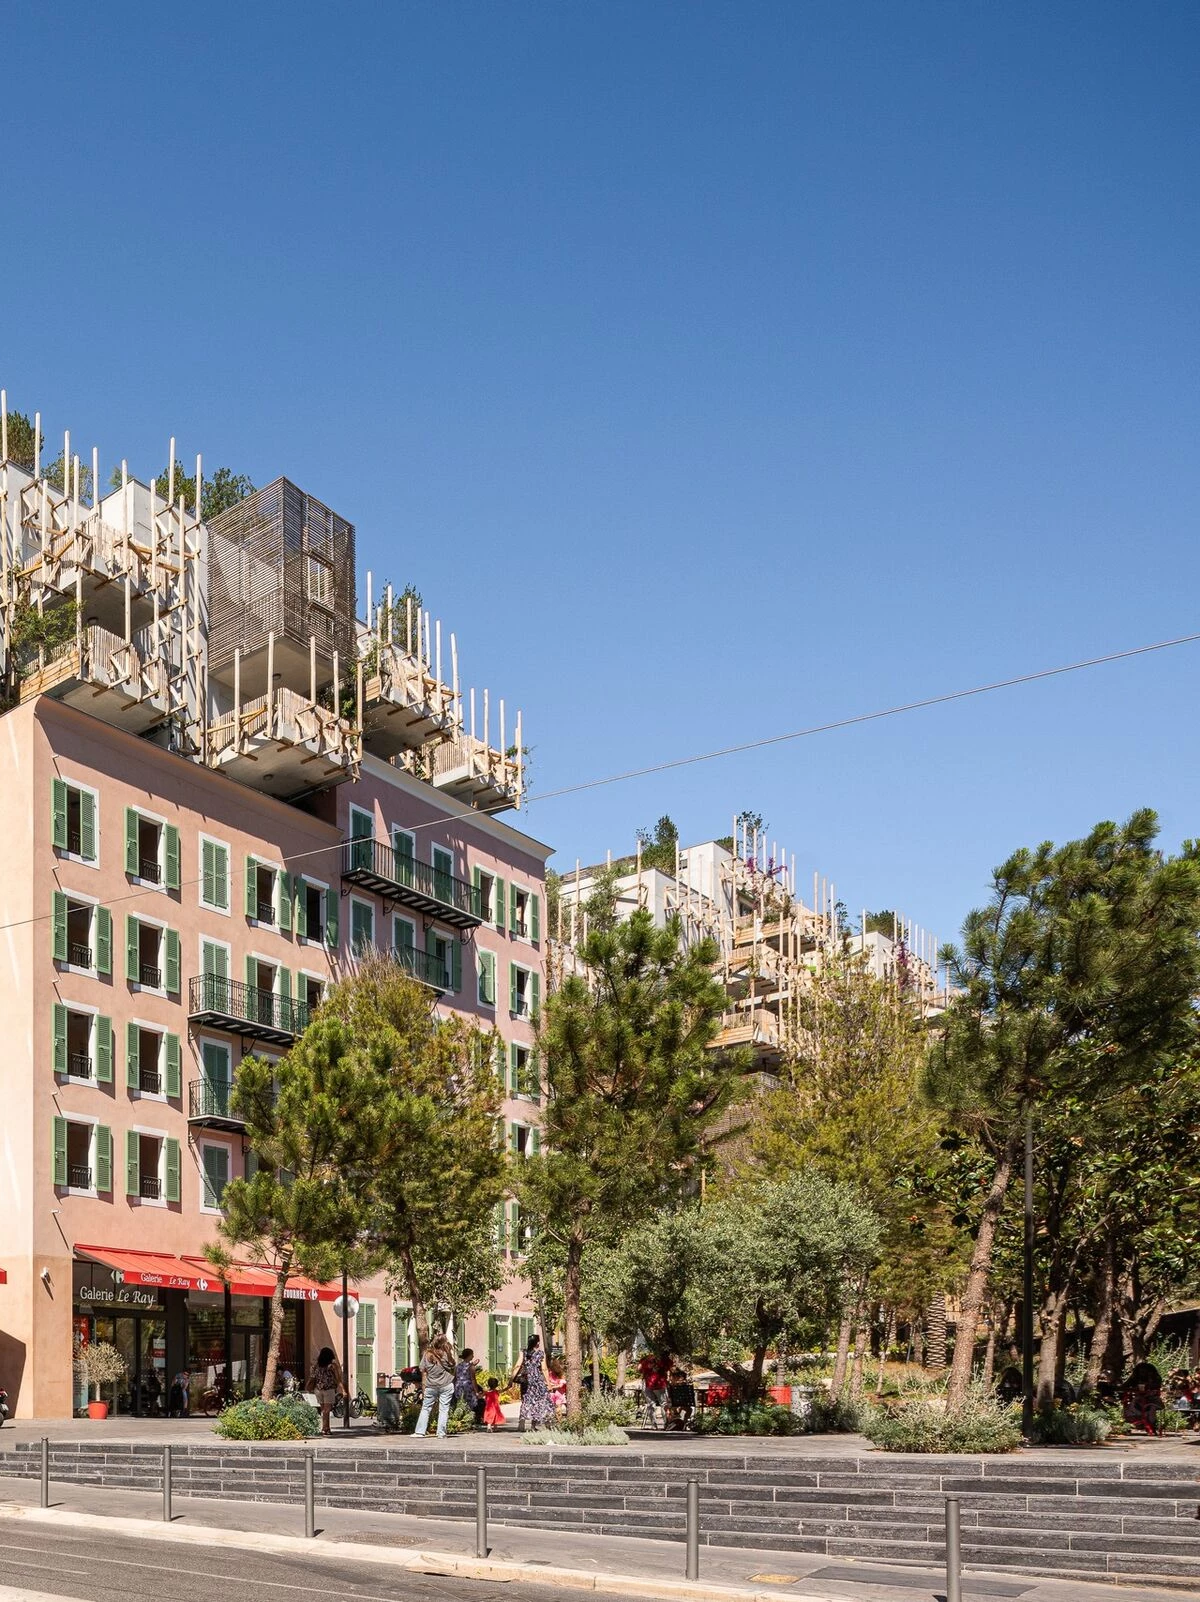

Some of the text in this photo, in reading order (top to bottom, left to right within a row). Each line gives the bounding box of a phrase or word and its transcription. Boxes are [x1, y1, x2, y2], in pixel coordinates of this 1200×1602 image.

[141, 1273, 190, 1288] Galerie Le Ray
[80, 1286, 154, 1309] Galerie Le Ray
